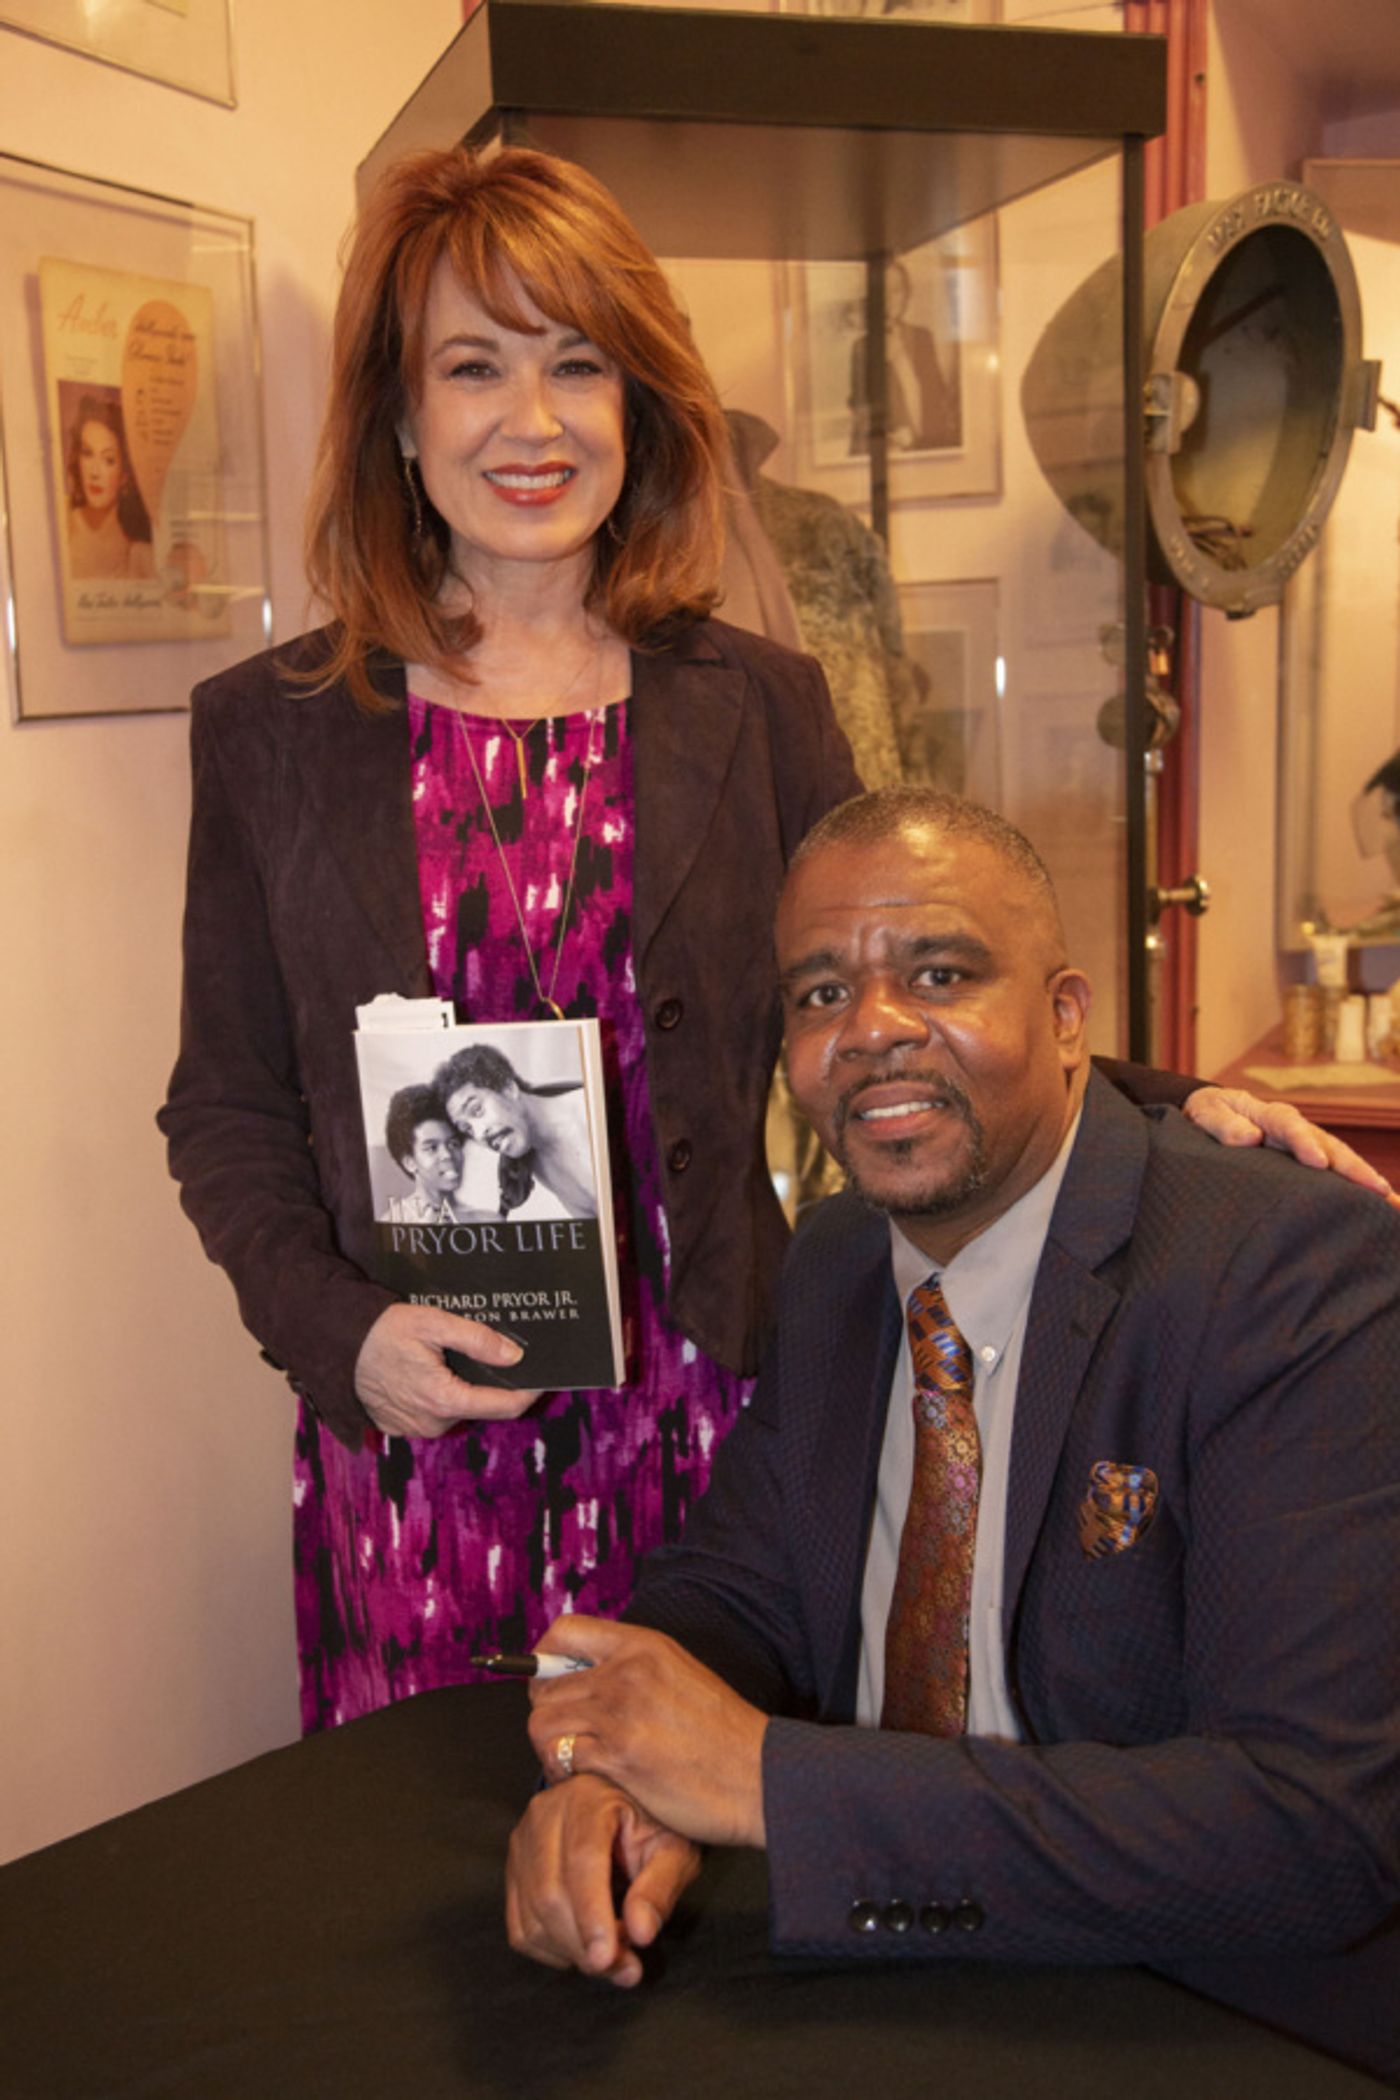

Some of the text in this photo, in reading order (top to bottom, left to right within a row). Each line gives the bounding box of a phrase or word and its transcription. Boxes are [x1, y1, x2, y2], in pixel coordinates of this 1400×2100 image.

[437, 1198, 459, 1224] A
[391, 1222, 586, 1255] PRYOR LIFE
[409, 1290, 578, 1310] RICHARD PRYOR JR.
[509, 1309, 580, 1322] BRAWER
